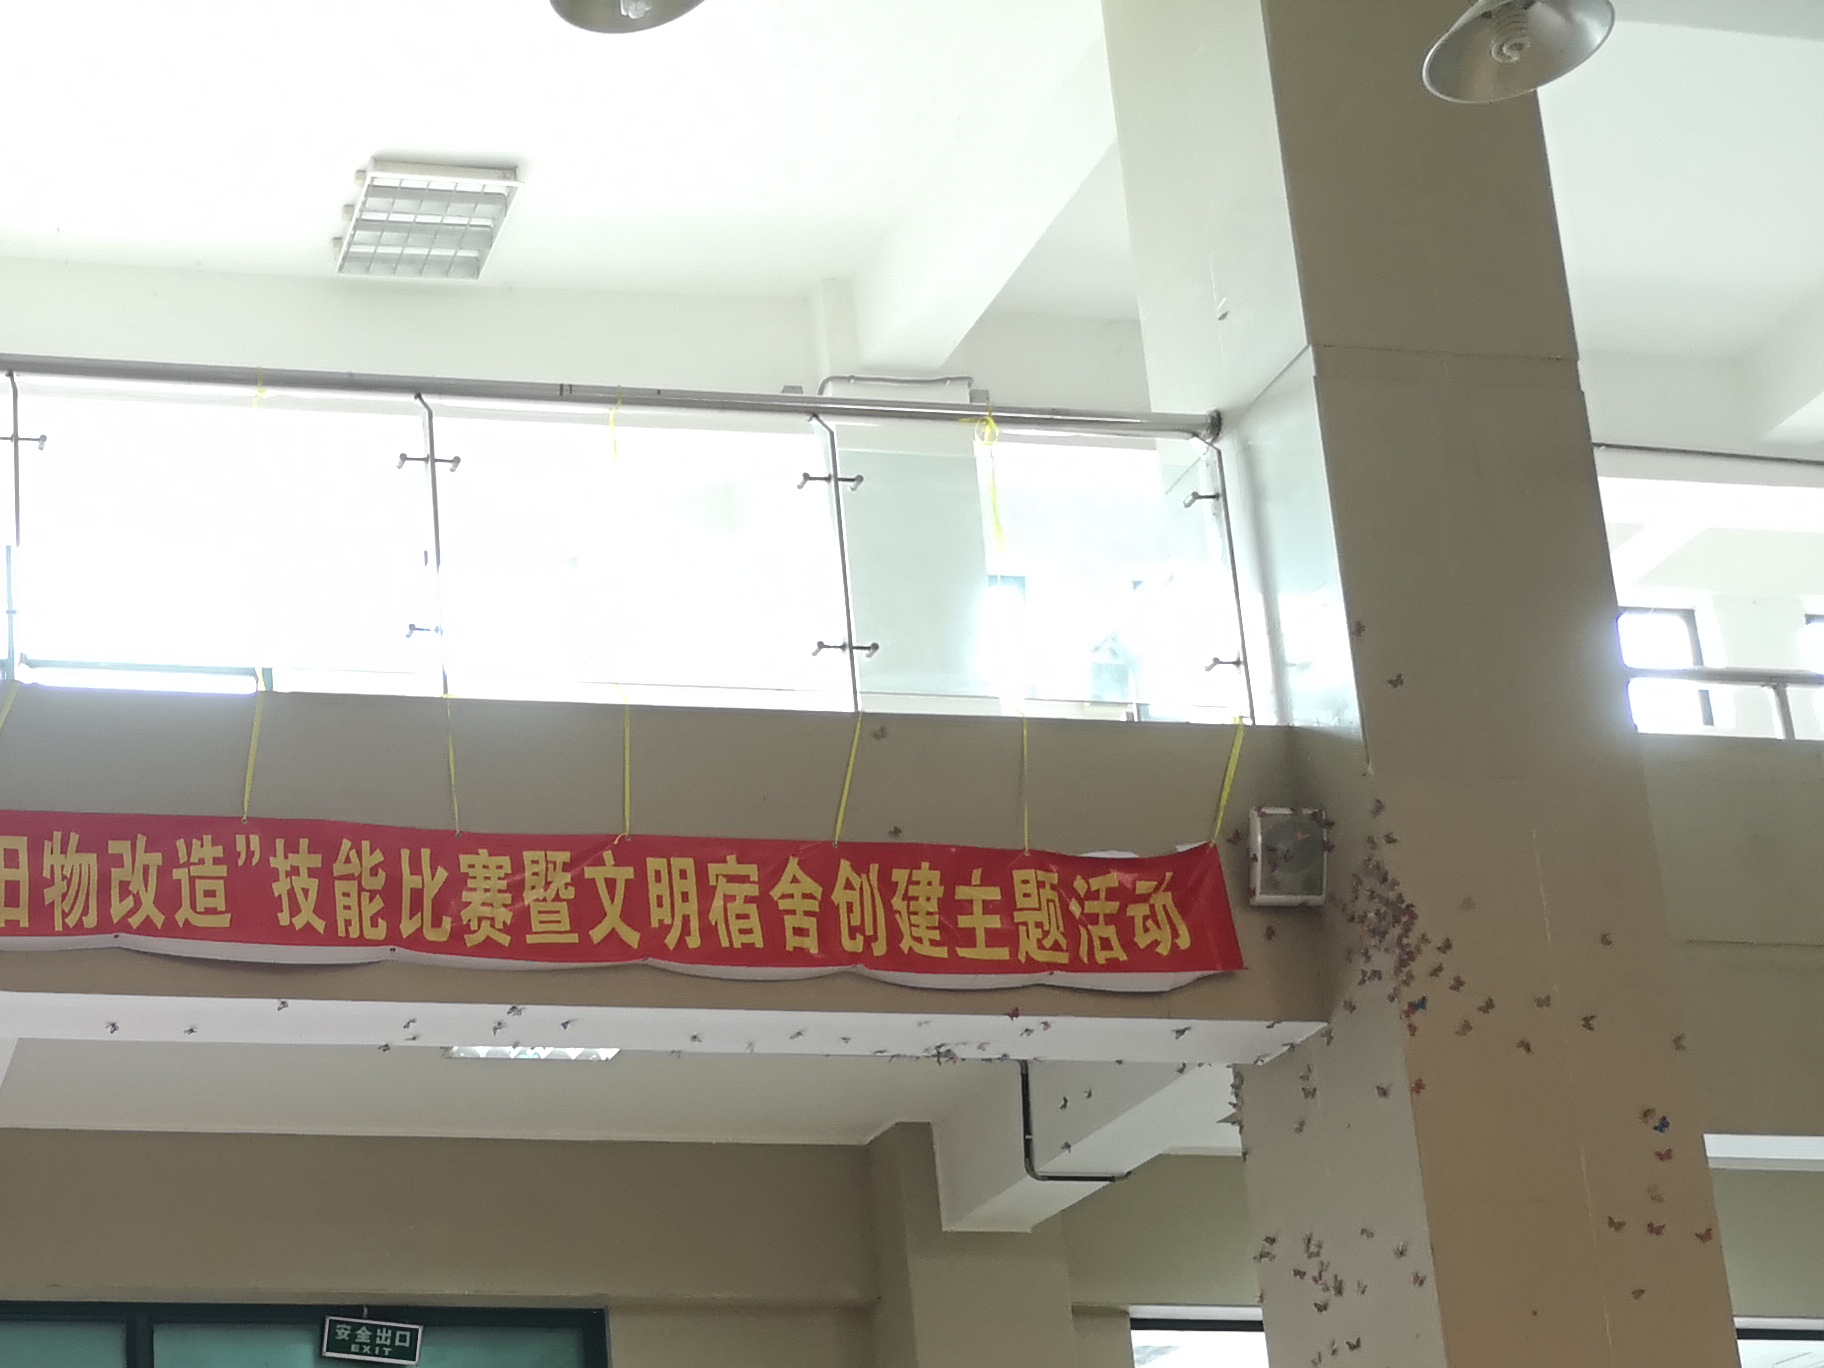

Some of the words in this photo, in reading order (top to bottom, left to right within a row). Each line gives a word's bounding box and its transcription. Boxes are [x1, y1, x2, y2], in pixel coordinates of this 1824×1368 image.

[335, 1324, 411, 1347] 安全出口
[351, 1344, 392, 1356] EXIT
